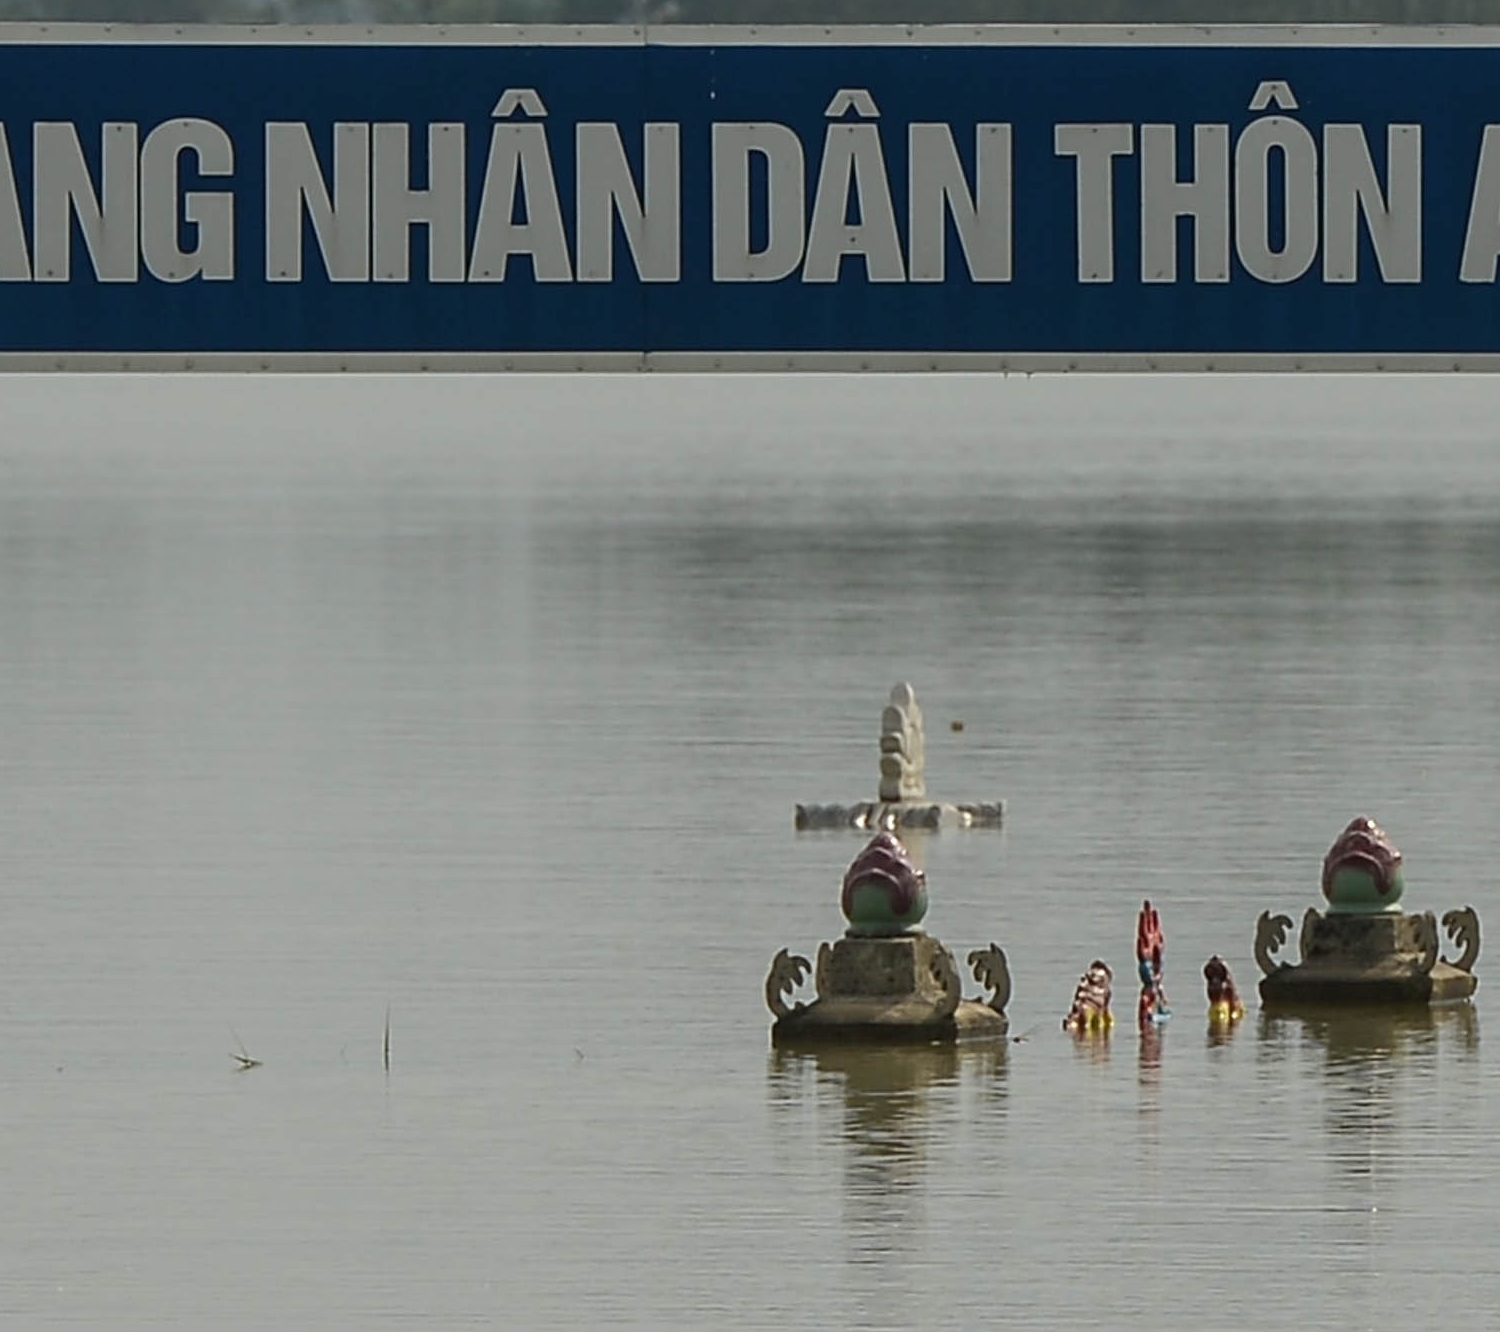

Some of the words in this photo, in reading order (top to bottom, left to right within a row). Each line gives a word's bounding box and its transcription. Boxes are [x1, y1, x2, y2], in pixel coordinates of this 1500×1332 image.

[264, 88, 681, 283] NHÂN
[711, 88, 1013, 283] DÂN
[1053, 80, 1423, 284] THÔN
